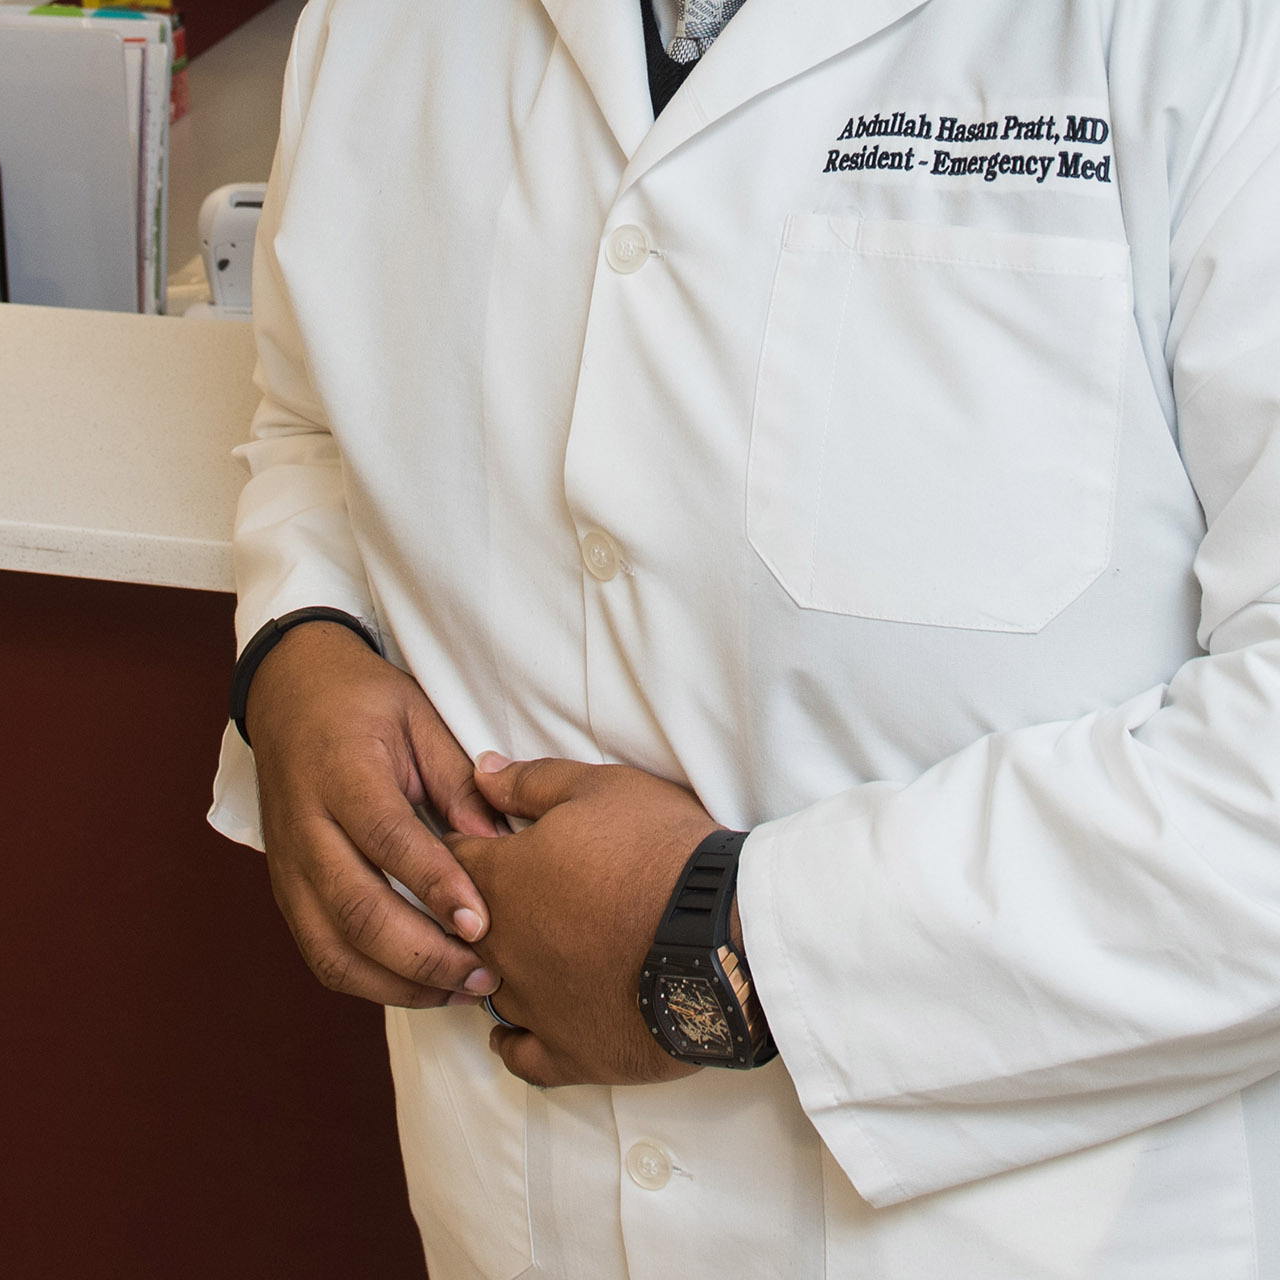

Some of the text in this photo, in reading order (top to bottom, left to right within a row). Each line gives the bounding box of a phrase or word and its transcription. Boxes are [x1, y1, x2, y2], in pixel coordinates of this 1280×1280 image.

[836, 111, 1109, 145] Abdullah Hasan Pratt, MD
[822, 144, 915, 173] Resident
[929, 149, 1055, 184] Emergency
[1056, 151, 1111, 183] Med
